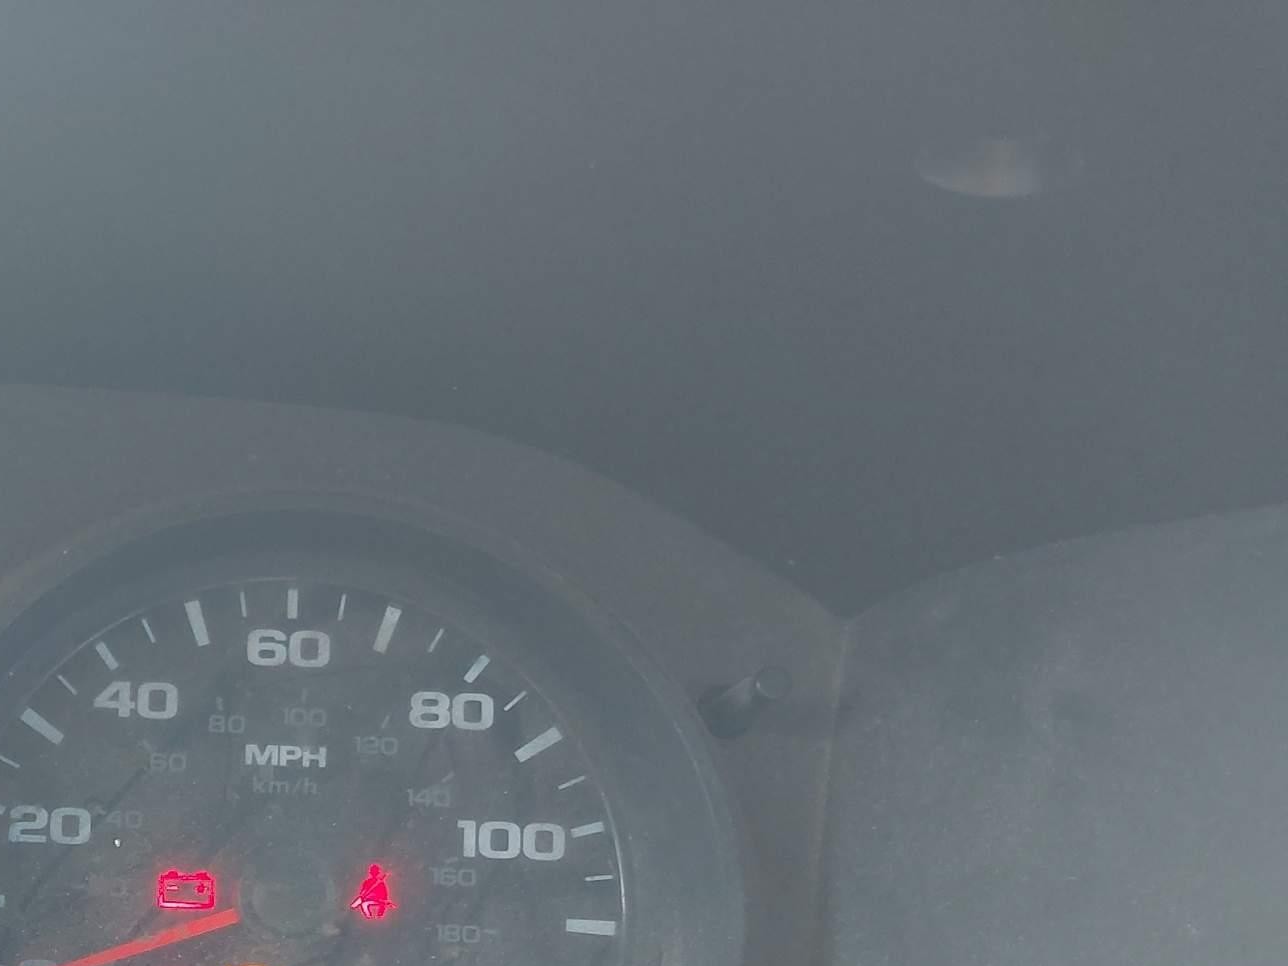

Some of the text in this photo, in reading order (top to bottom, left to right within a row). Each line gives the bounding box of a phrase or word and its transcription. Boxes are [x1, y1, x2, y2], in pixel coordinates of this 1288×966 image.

[246, 629, 330, 667] 60
[94, 681, 178, 719] 40
[409, 692, 494, 730] 80
[208, 714, 245, 735] 80
[283, 706, 326, 728] 100
[244, 743, 327, 768] MPH
[354, 736, 398, 757] 120
[150, 751, 187, 772] 60
[252, 775, 319, 796] km/h
[9, 806, 91, 845] 20
[457, 820, 566, 861] 100
